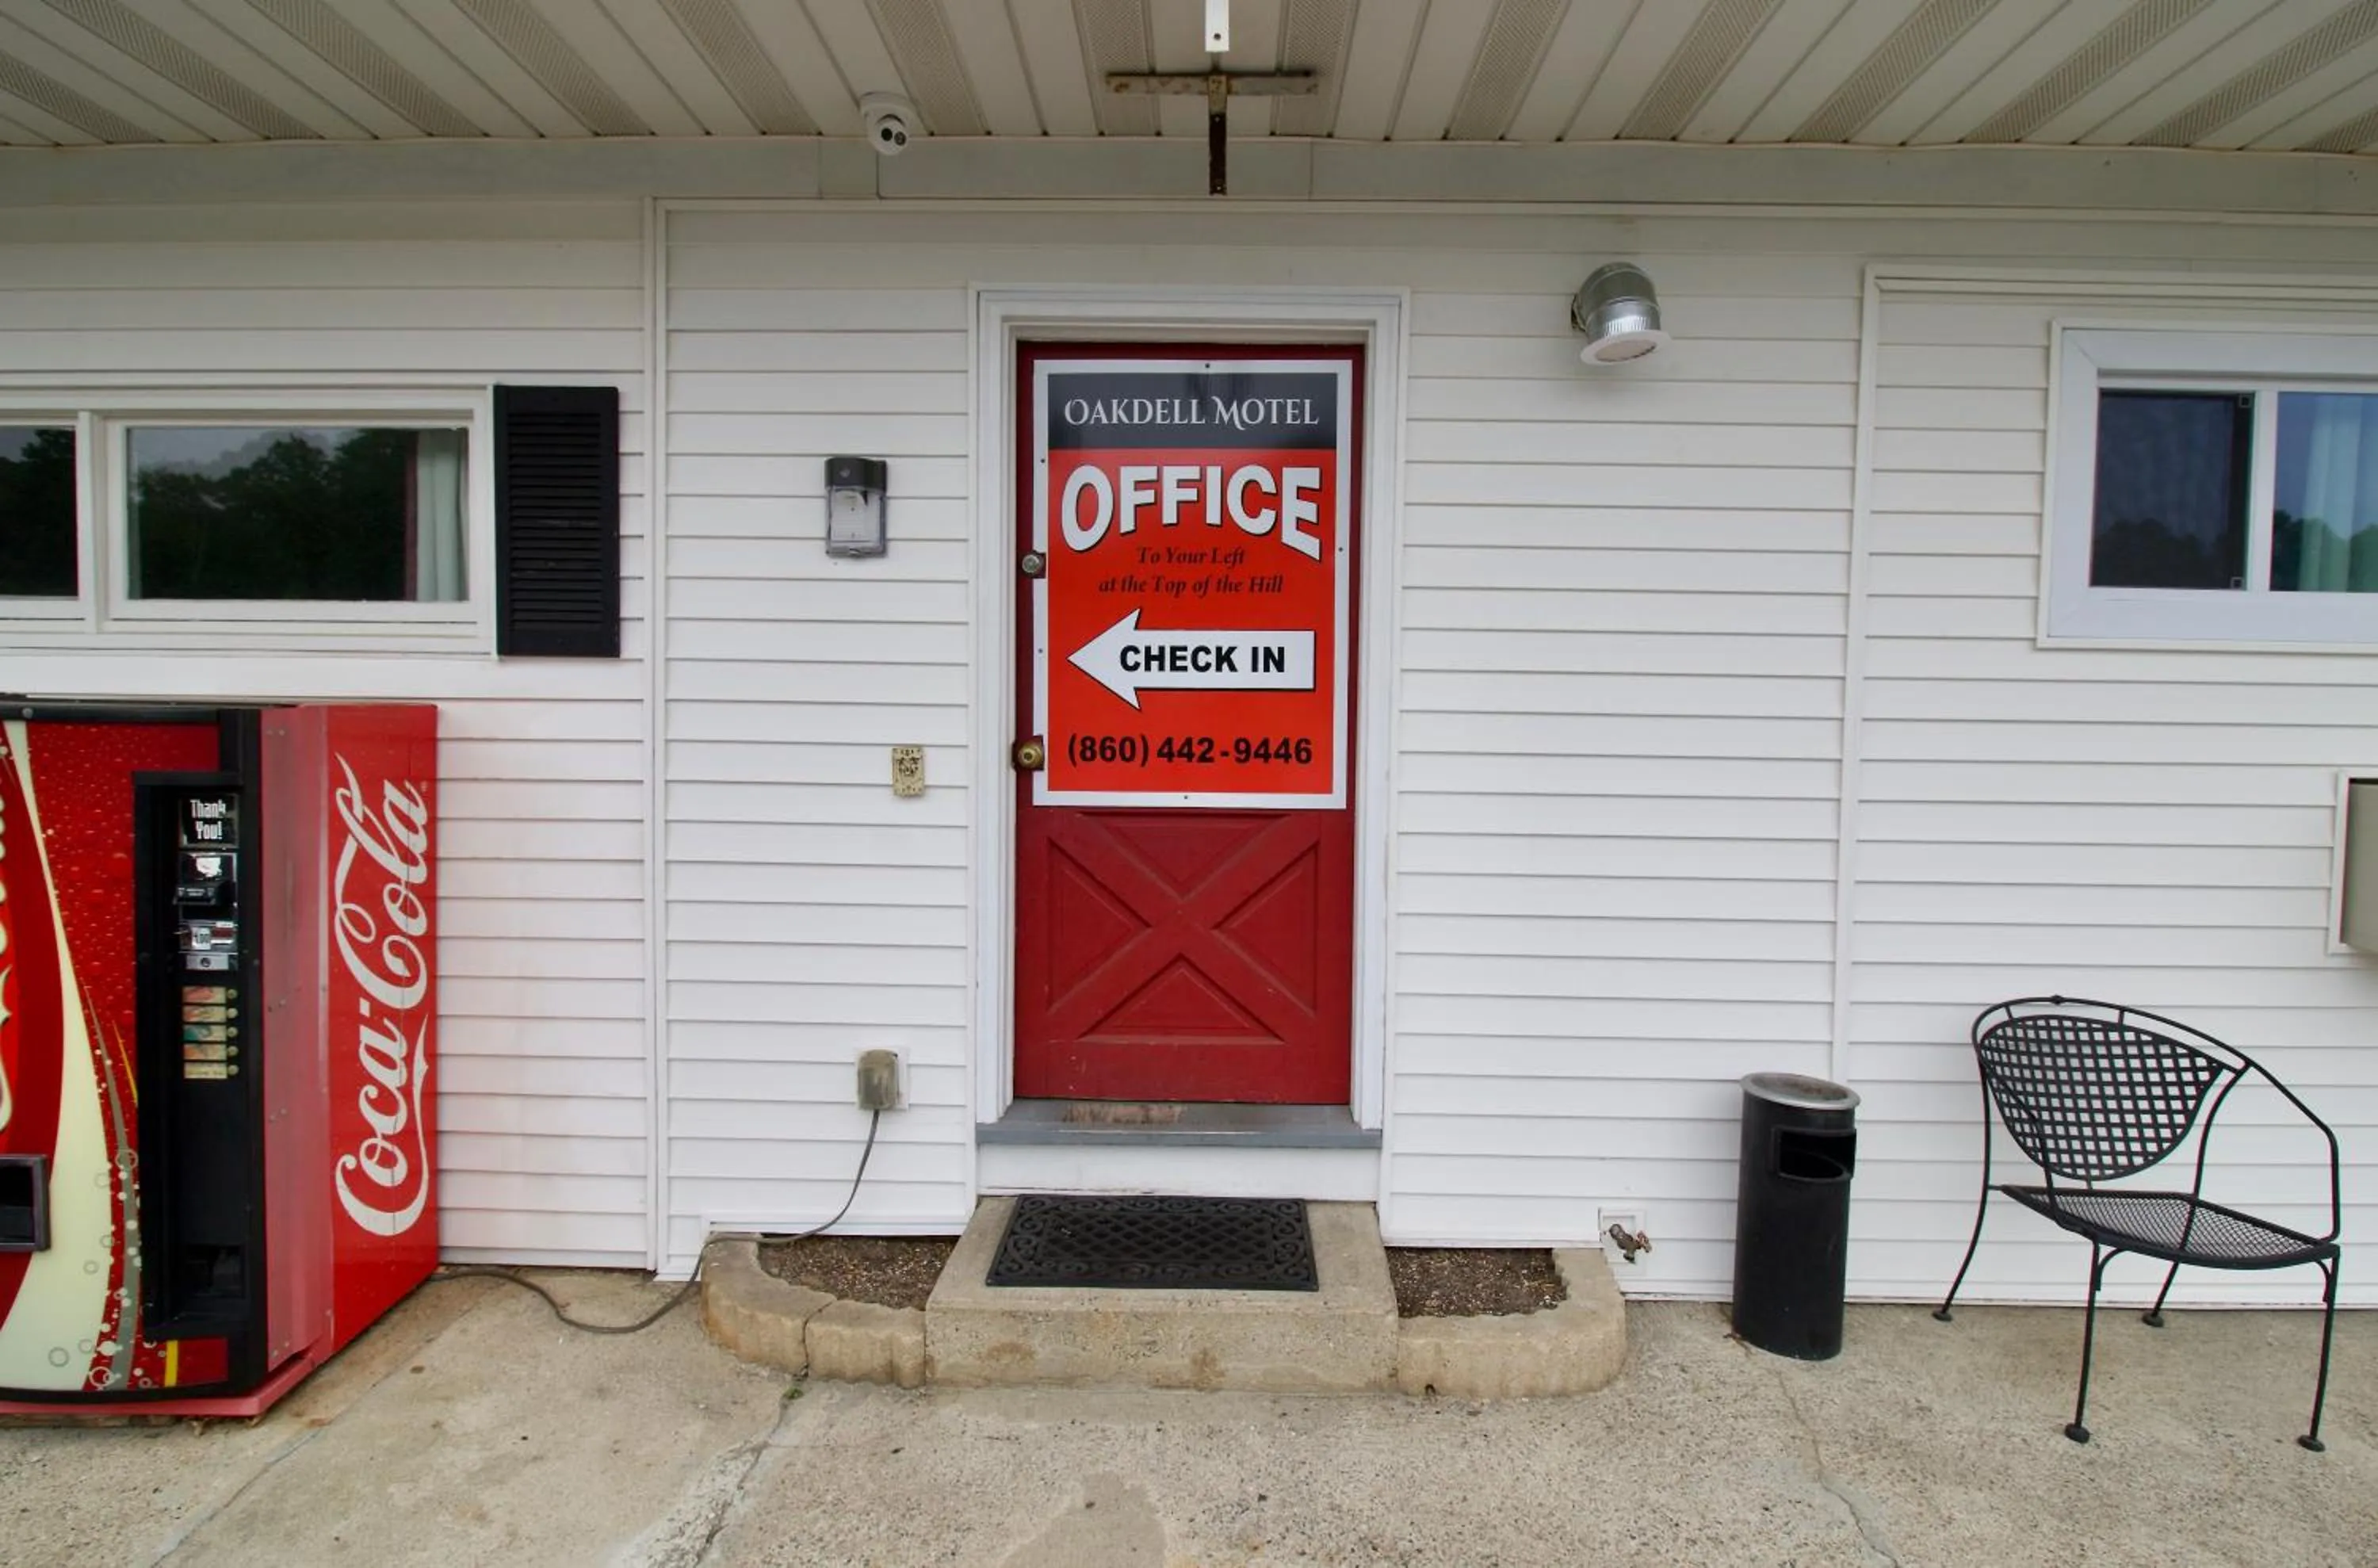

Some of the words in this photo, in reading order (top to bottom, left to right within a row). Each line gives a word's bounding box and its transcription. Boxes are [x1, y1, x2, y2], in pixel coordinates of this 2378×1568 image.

[1064, 397, 1207, 426] OAKDELL
[1211, 396, 1319, 431] MOTEL
[1061, 463, 1322, 562] OFFICE
[1137, 546, 1160, 564] To
[1166, 546, 1207, 564] Your
[1210, 545, 1245, 569] Left
[1099, 576, 1116, 593] at
[1121, 575, 1147, 593] the
[1153, 575, 1187, 599] Top
[1191, 574, 1213, 598] of
[1217, 575, 1243, 593] the
[1248, 574, 1284, 593] Hill
[1119, 644, 1239, 674] CHECK
[1251, 644, 1286, 674] IN
[1067, 732, 1149, 767] (860)
[1156, 736, 1313, 765] 442-9446
[189, 798, 226, 819] Thank
[194, 820, 224, 840] You!
[334, 751, 429, 1237] Coca-Cola
